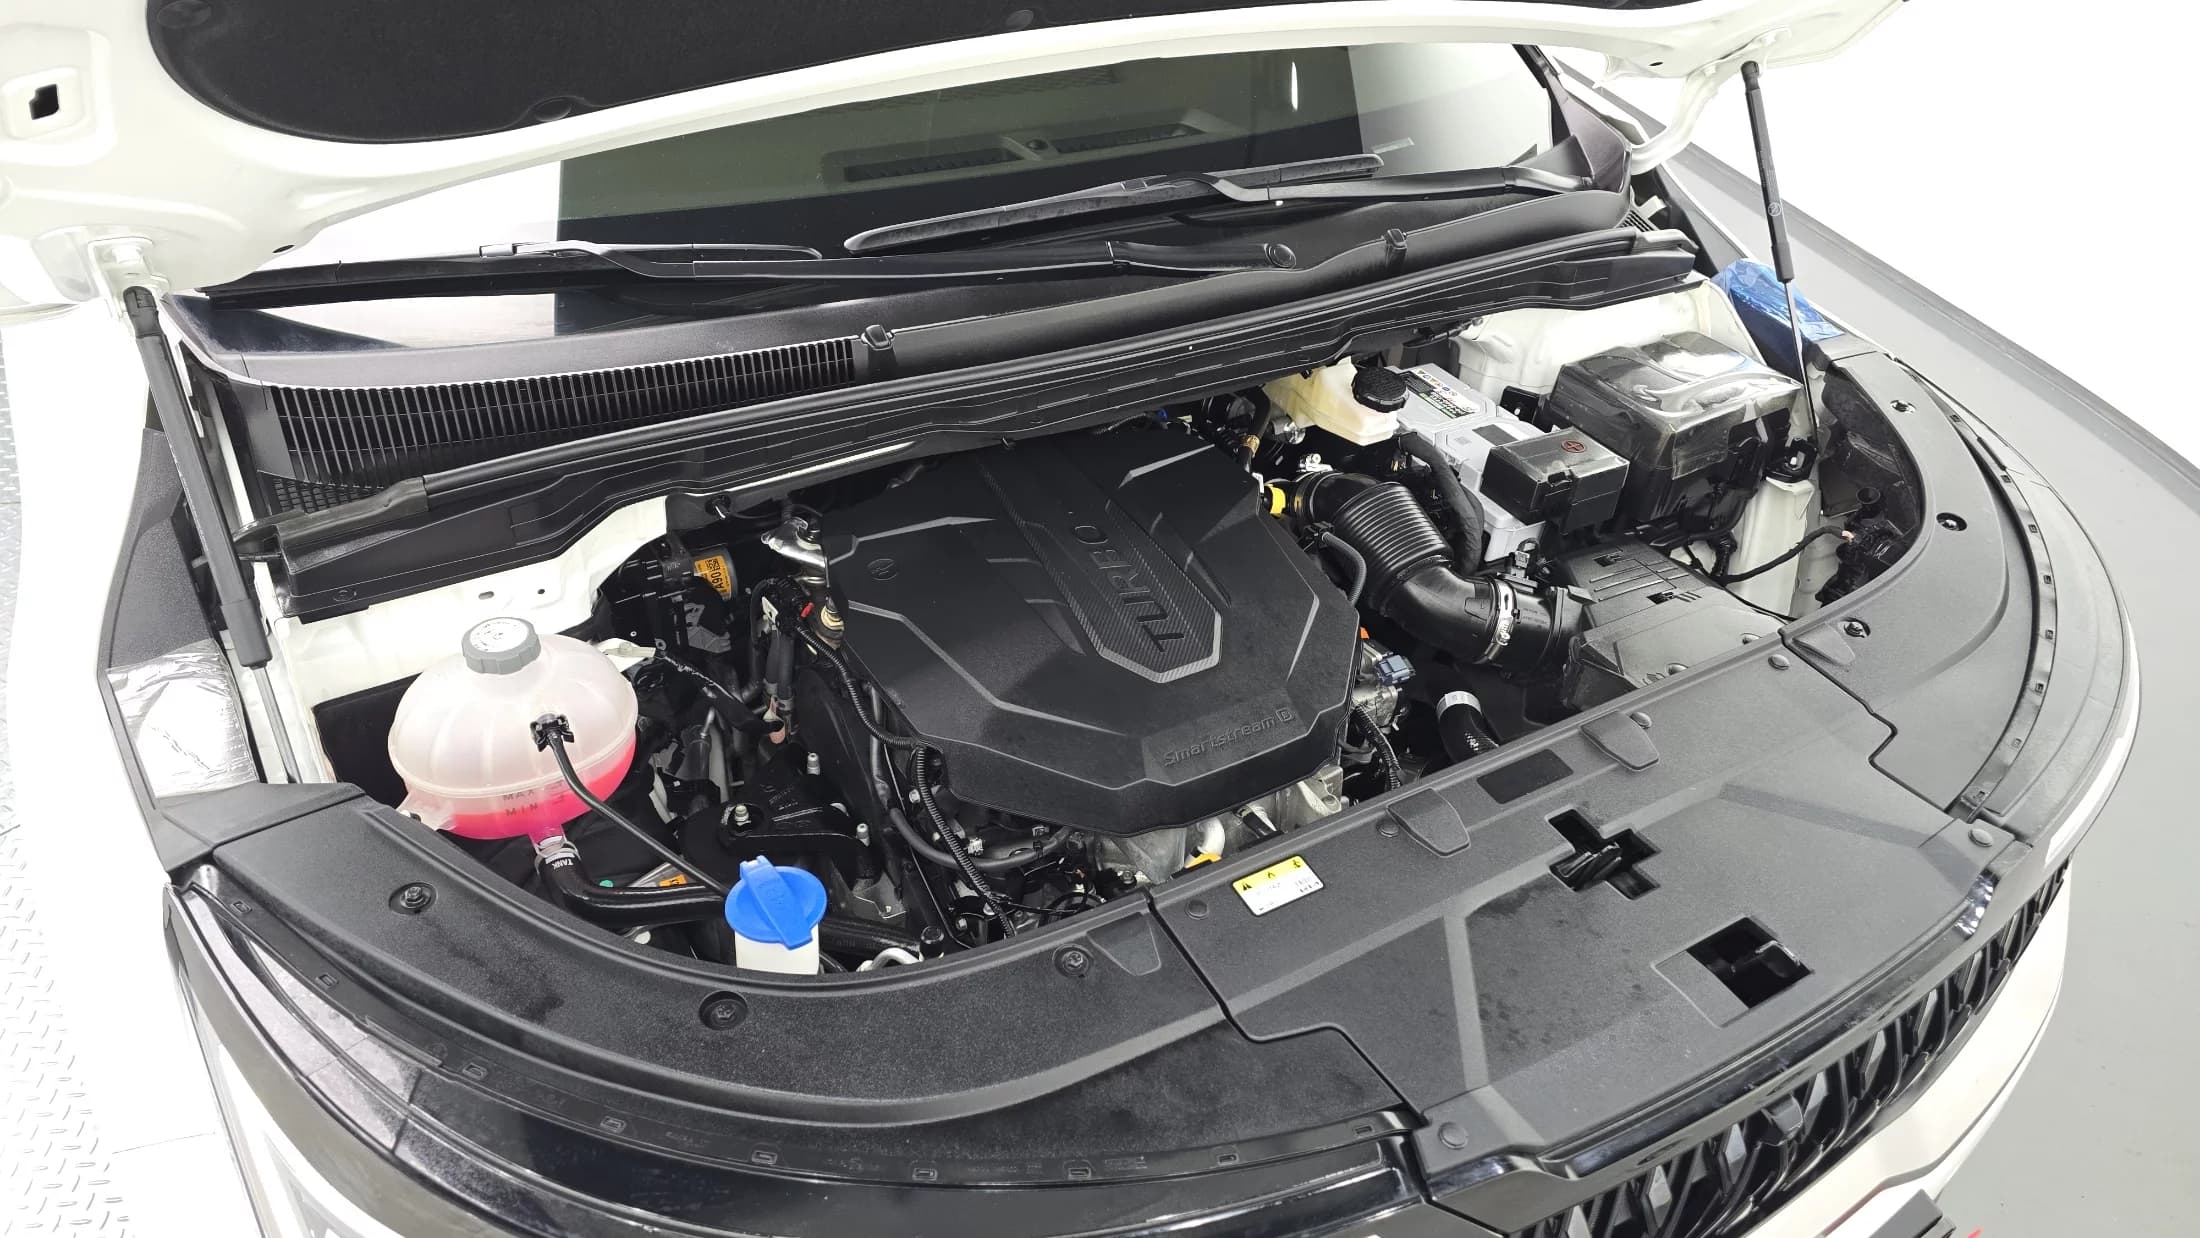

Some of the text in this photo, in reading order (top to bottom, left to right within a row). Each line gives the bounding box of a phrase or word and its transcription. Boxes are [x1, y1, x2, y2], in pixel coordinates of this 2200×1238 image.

[1072, 524, 1185, 653] TURBO
[1162, 715, 1276, 768] Smartstream
[503, 788, 535, 801] MAX
[505, 802, 538, 816] MIN
[551, 858, 574, 870] TANK
